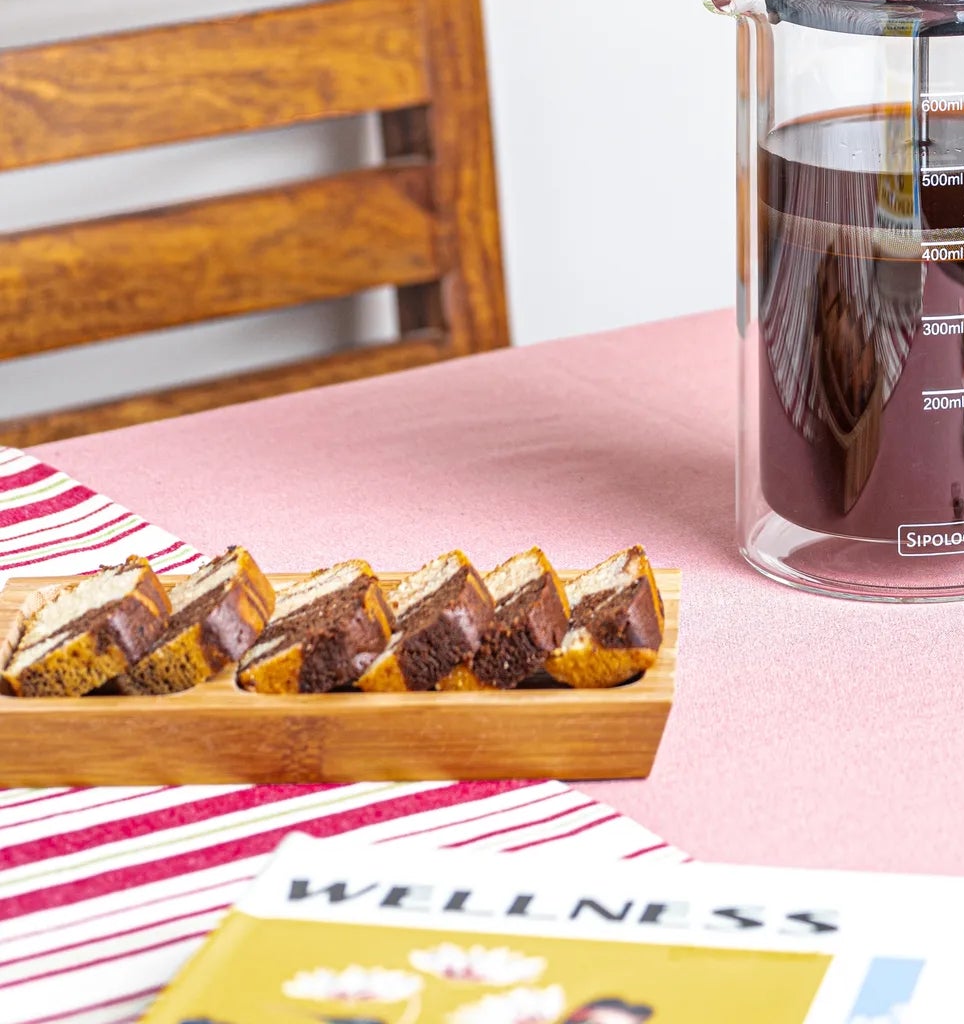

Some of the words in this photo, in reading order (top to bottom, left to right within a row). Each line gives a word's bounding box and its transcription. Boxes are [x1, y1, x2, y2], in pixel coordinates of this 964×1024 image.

[921, 98, 963, 112] 600ml
[921, 172, 964, 187] 500ml
[921, 247, 964, 261] 400ml
[922, 321, 964, 336] 300ml
[923, 395, 964, 410] 200ml
[287, 878, 840, 934] WELLNESS
